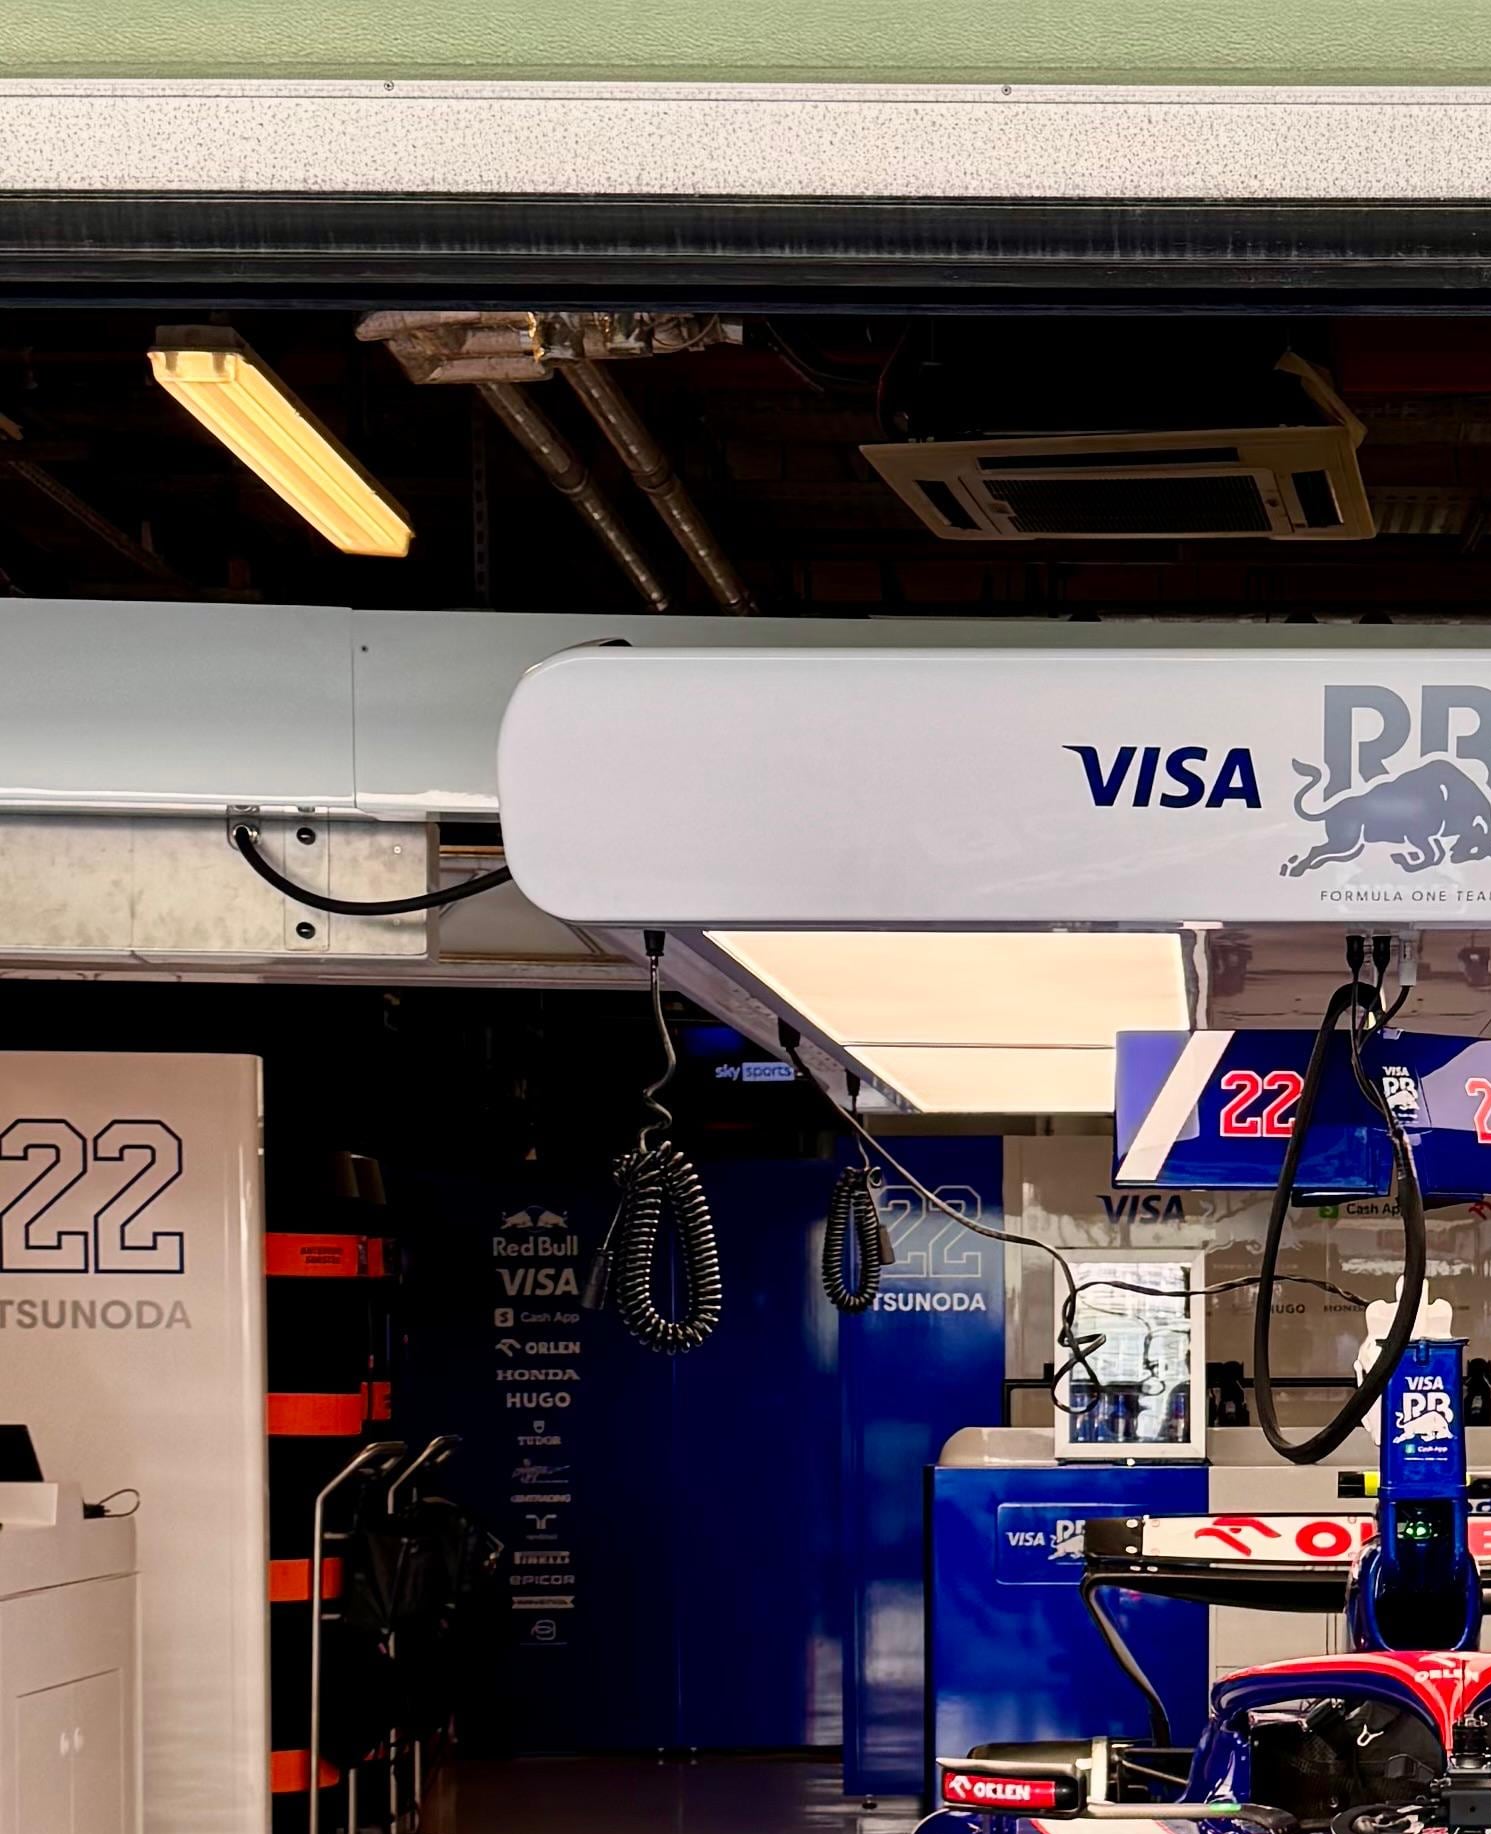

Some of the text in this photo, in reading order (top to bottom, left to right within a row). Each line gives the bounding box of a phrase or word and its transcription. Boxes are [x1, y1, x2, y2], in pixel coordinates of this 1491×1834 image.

[1061, 746, 1262, 809] VISA
[1320, 890, 1403, 902] FORMULA
[1411, 890, 1450, 902] ONE
[714, 1063, 793, 1081] sky sports
[1382, 1066, 1410, 1076] VISA
[1219, 1069, 1303, 1137] 22
[0, 1119, 184, 1274] 22
[1096, 1194, 1187, 1225] VISA
[1346, 1203, 1400, 1217] Cash Ap
[880, 1185, 982, 1278] 22
[493, 1235, 578, 1256] Red Bull
[496, 1268, 579, 1296] VISA
[873, 1293, 986, 1311] TSUNODA
[1324, 1305, 1366, 1313] HOND
[525, 1341, 580, 1354] ORLEN
[496, 1369, 580, 1380] HONDA
[1404, 1376, 1444, 1390] VISA
[506, 1392, 571, 1408] HUGO
[518, 1436, 561, 1445] TUDOR
[1005, 1532, 1046, 1546] VISA
[973, 1780, 1031, 1801] ORLEN
